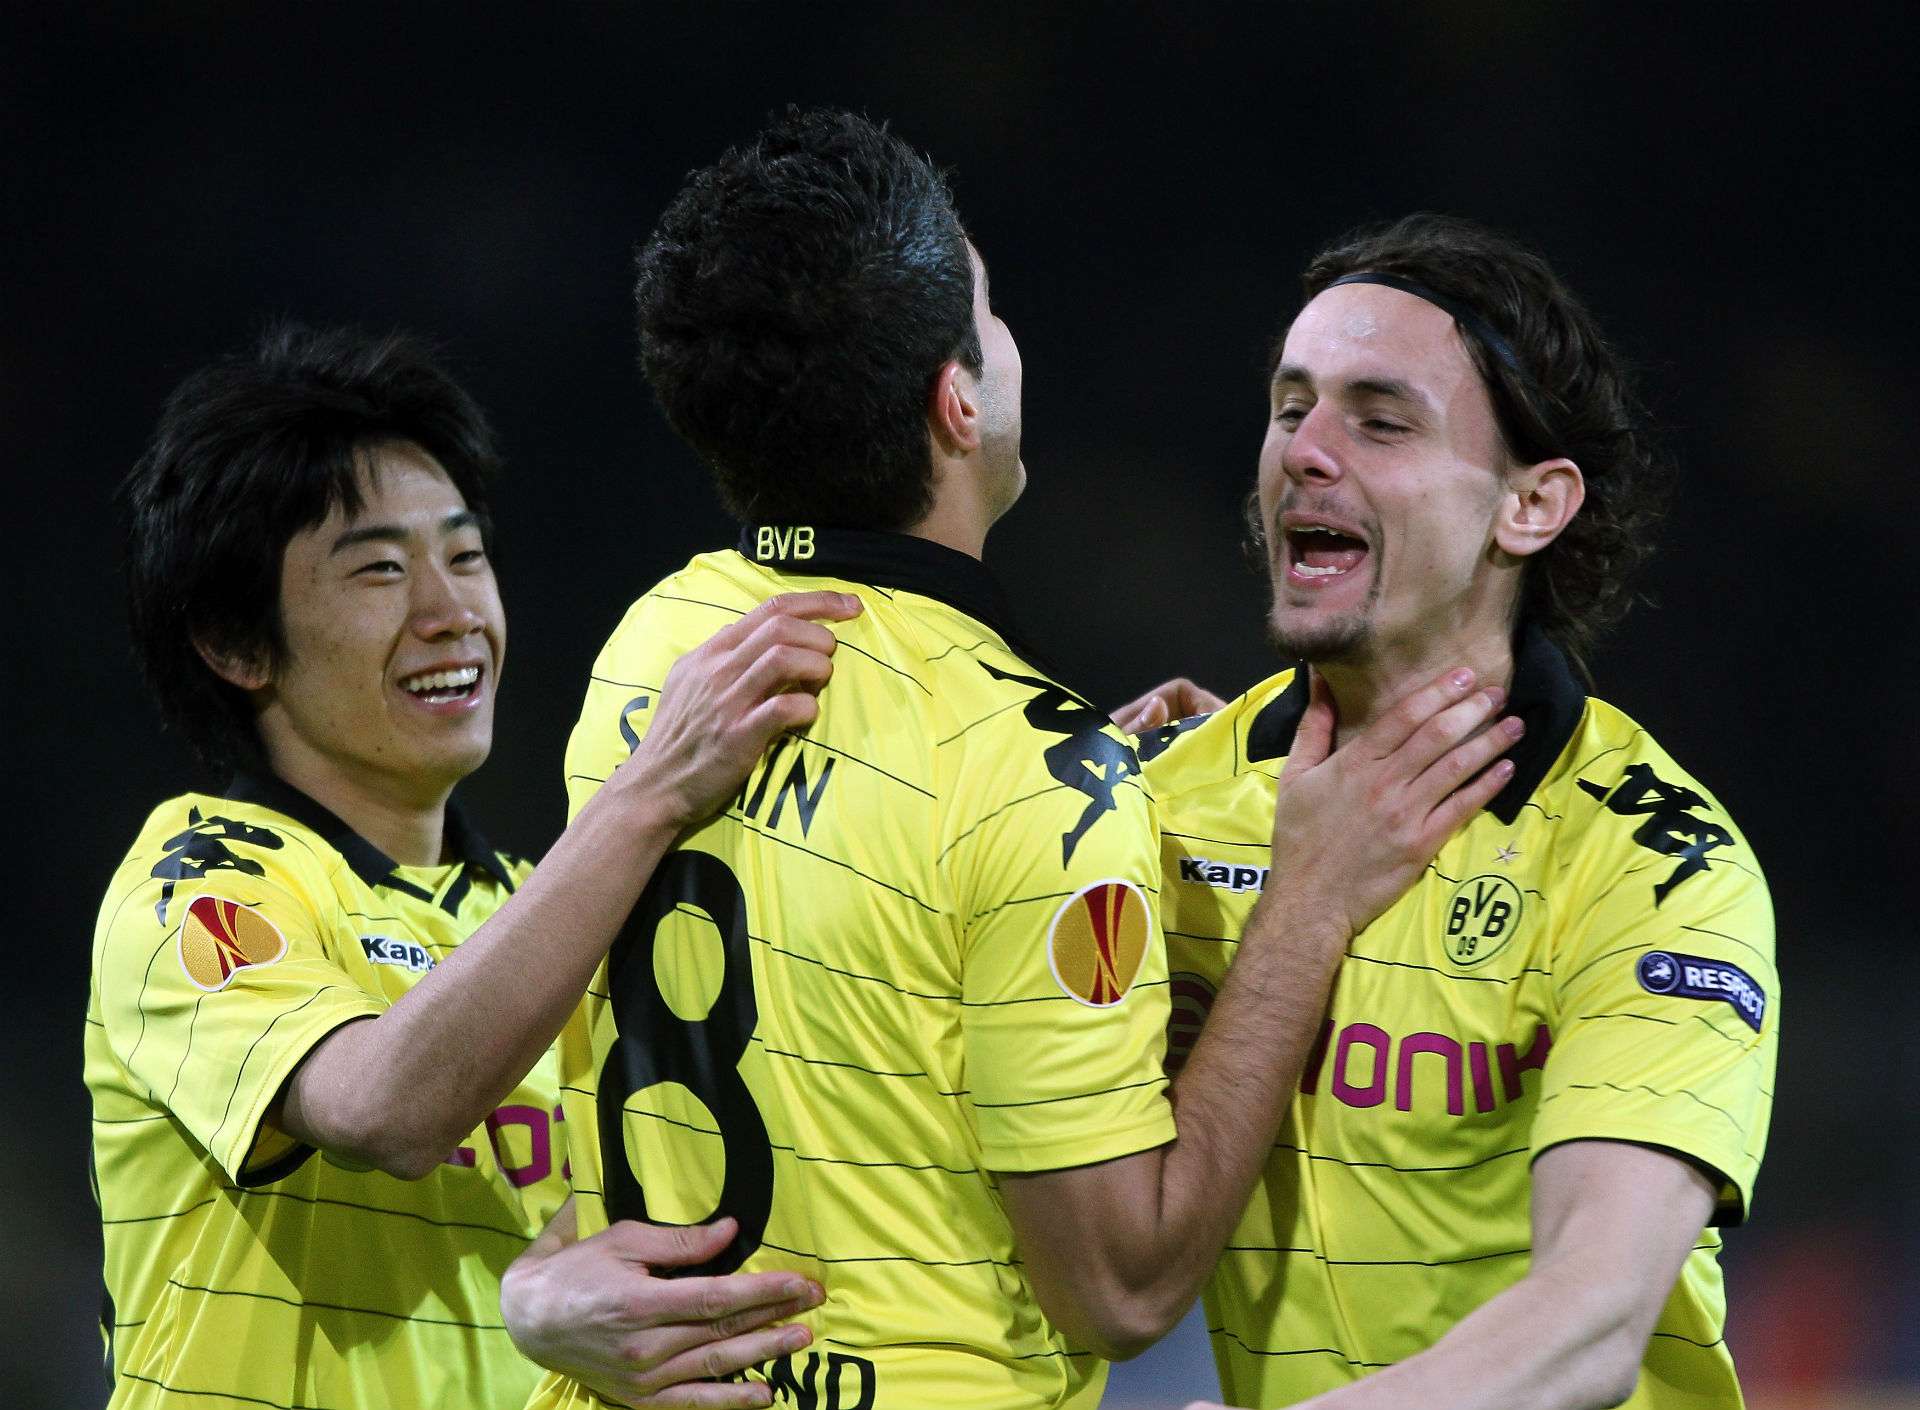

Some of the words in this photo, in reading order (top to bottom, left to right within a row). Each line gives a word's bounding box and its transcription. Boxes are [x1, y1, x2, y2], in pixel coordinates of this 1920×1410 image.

[756, 526, 815, 560] BVB
[616, 696, 836, 840] SIN
[1447, 881, 1511, 937] BVB
[1457, 936, 1478, 956] 09
[599, 850, 774, 1279] 8
